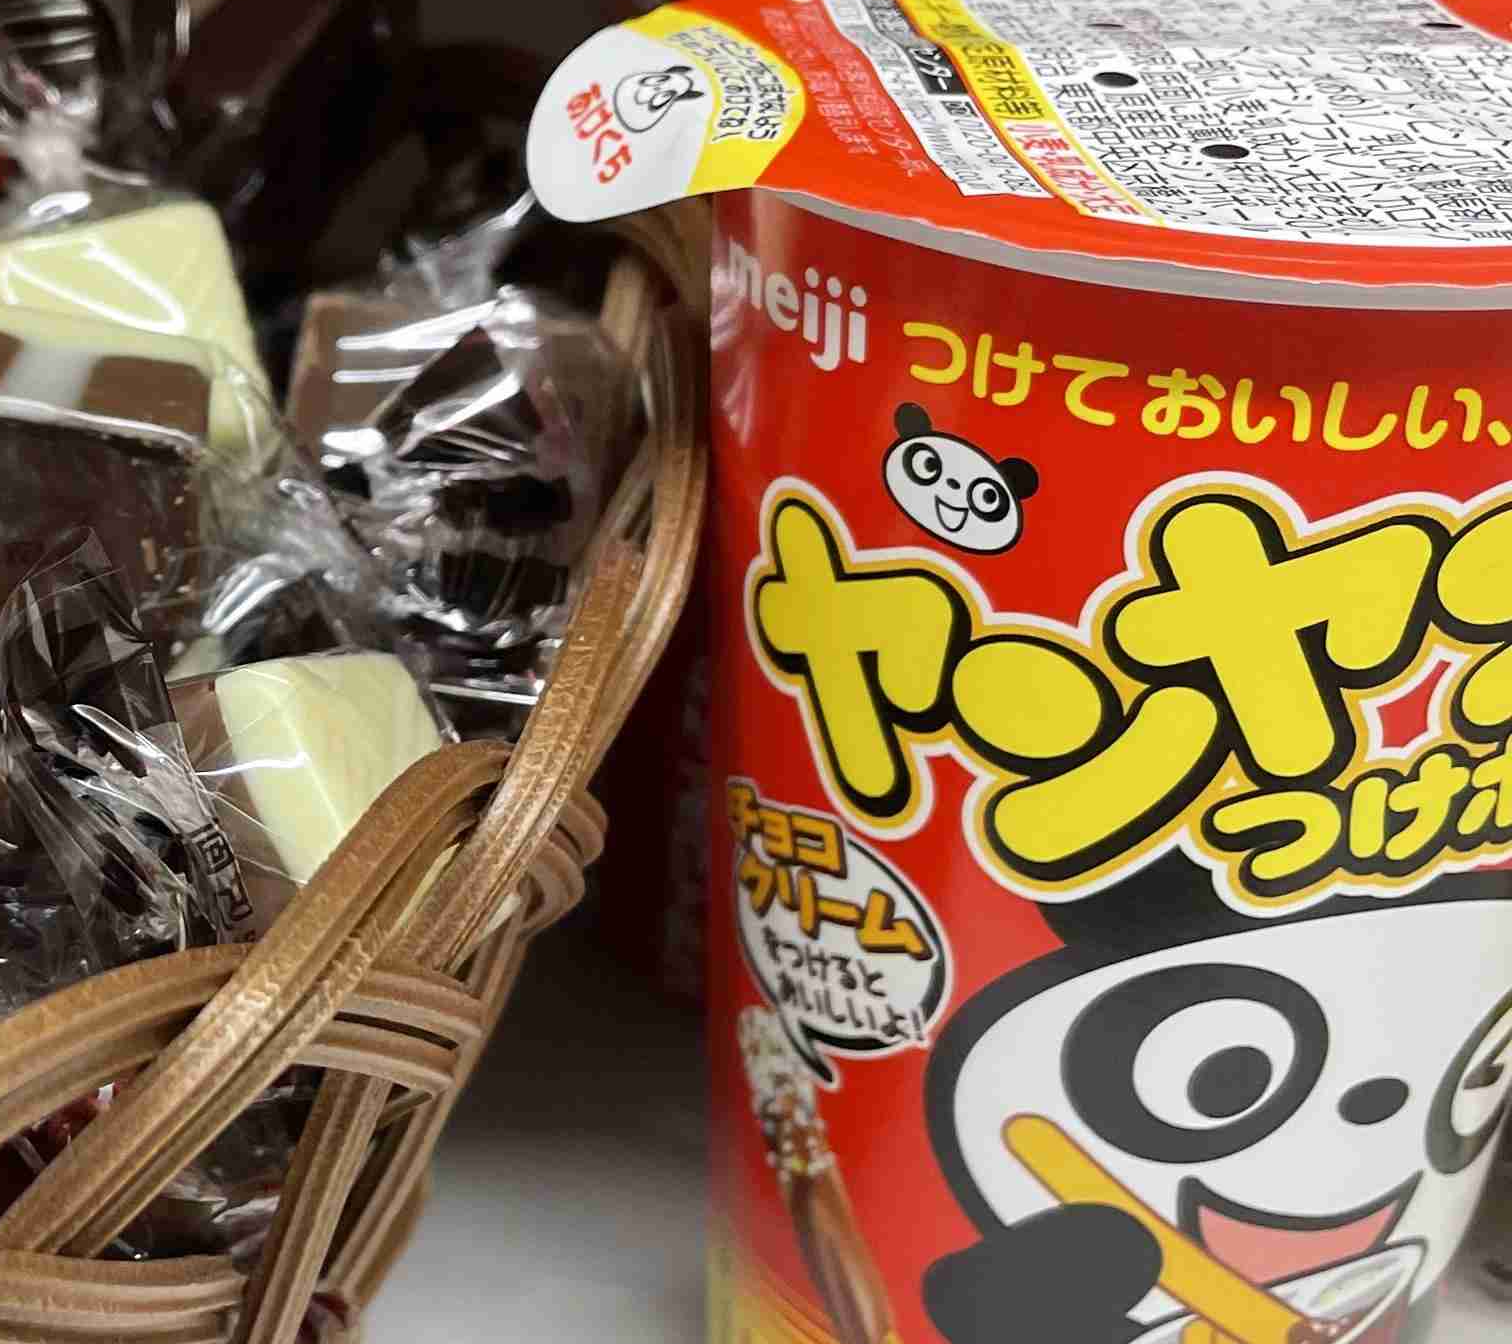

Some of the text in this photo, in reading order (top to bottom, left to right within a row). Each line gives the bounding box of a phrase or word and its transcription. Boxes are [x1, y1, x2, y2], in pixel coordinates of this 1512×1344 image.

[754, 494, 1512, 880] ヤンヤ
[728, 782, 847, 878] チョコ
[739, 854, 933, 960] クリーム
